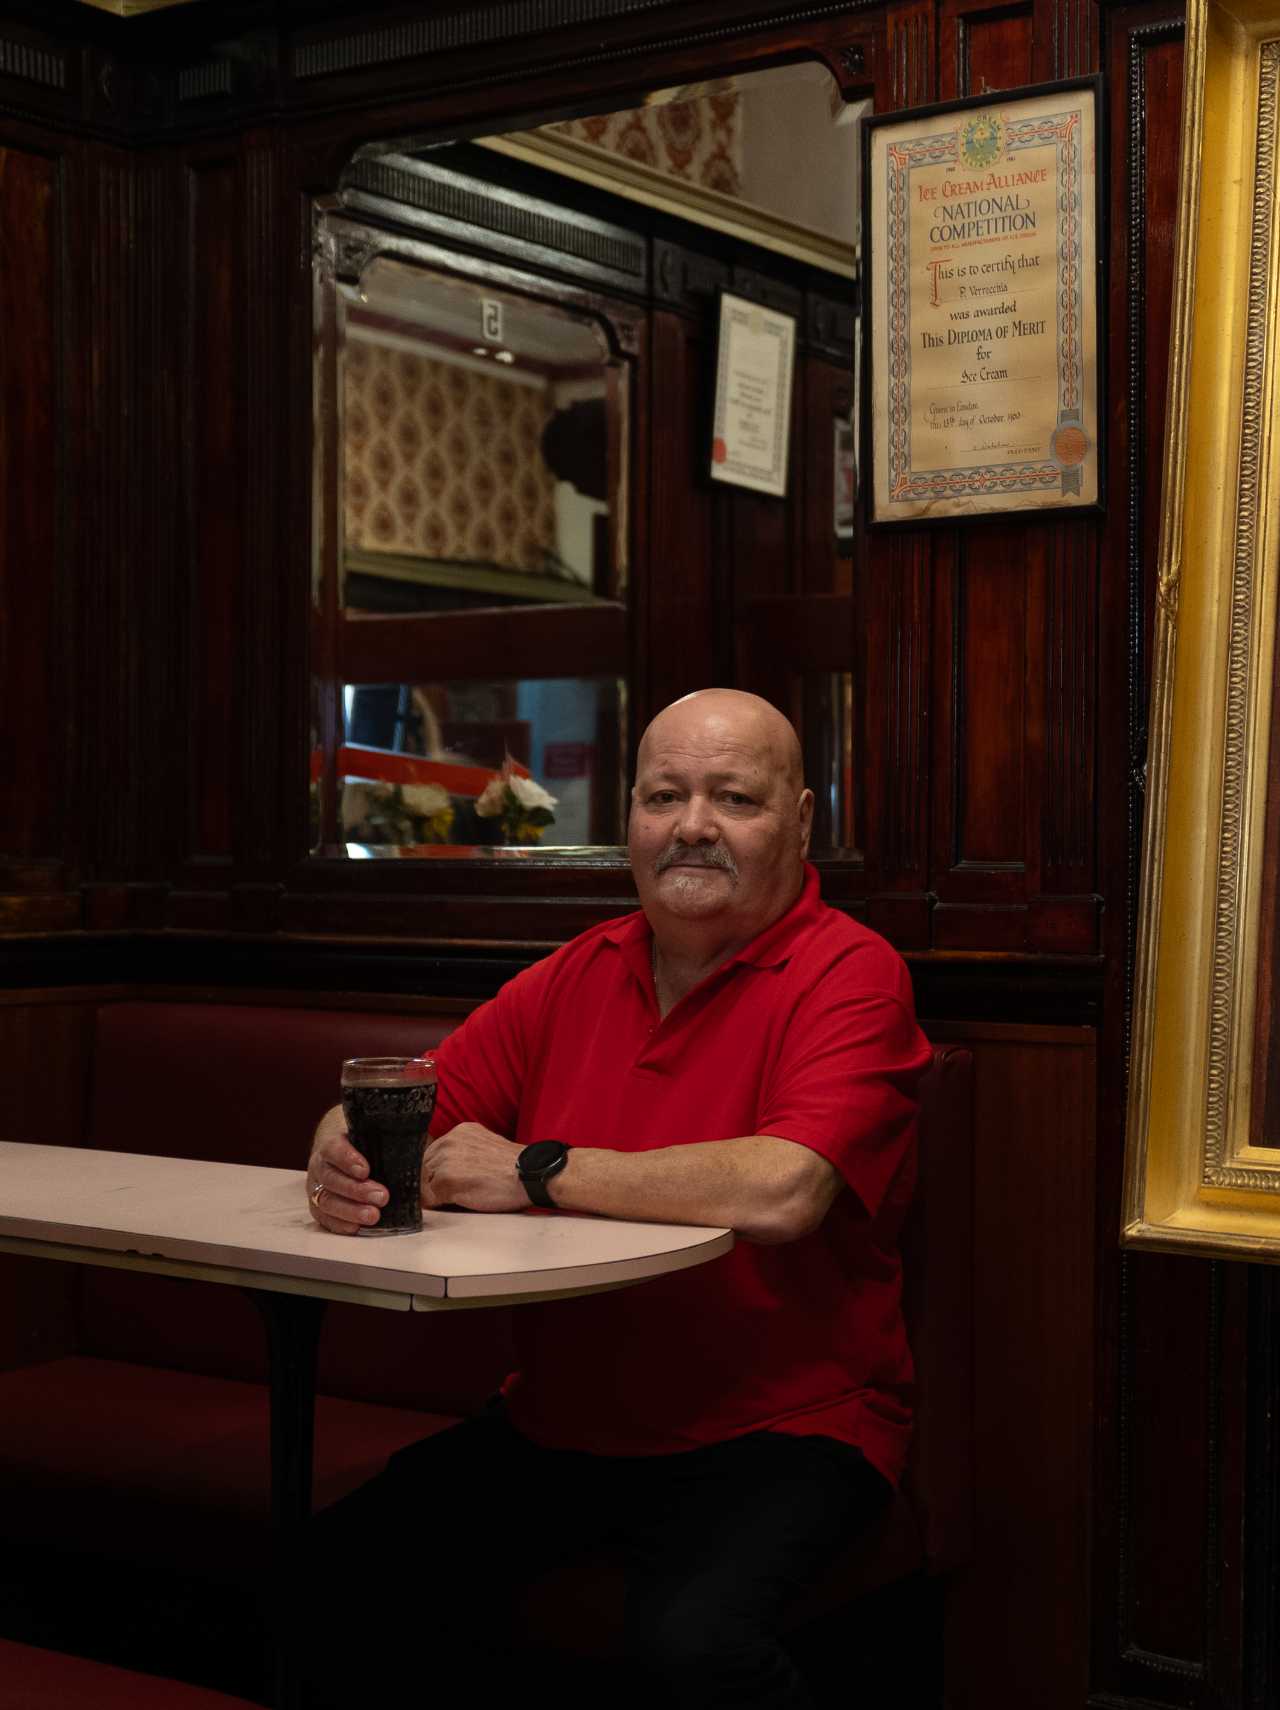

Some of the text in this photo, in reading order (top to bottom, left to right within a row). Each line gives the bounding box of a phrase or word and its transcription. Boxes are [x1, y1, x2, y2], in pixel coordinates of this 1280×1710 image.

[918, 168, 1047, 202] ICE CREAM ALLIANCE
[934, 194, 1030, 222] NATIONAL
[930, 212, 1036, 243] COMPETITION
[926, 253, 1040, 307] This is to certify that
[949, 300, 1017, 321] was awarded
[921, 320, 1046, 348] This DIPLOMA OF MERIT
[975, 345, 992, 360] for
[960, 367, 1008, 384] Ice Cream
[956, 401, 979, 412] London
[979, 414, 1004, 424] October
[1006, 446, 1041, 454] PRESIDENT
